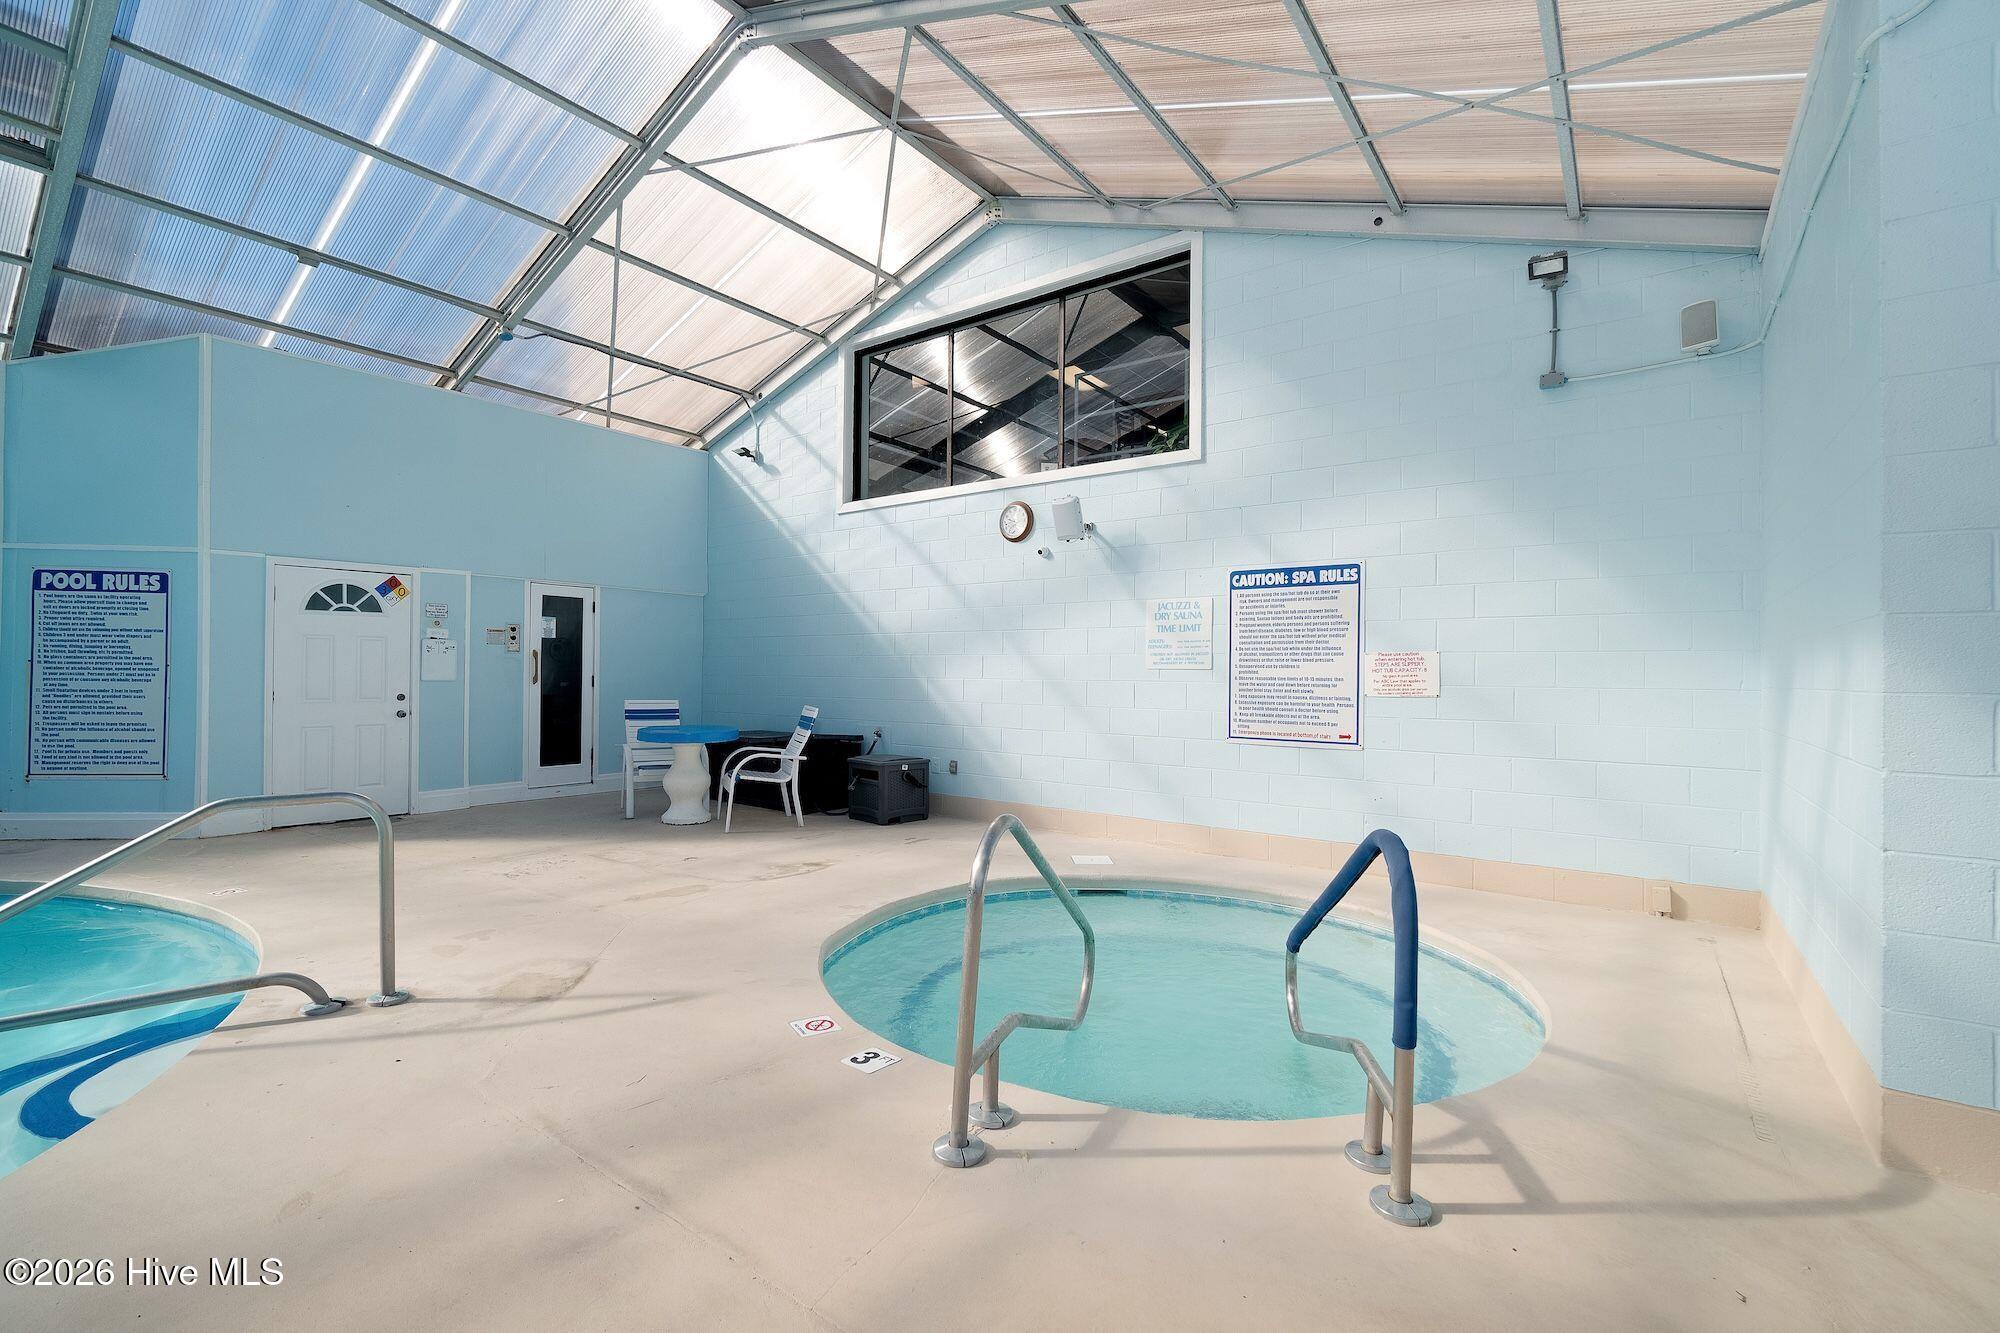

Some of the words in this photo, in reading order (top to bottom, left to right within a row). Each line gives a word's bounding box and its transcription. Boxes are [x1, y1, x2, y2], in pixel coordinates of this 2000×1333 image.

[40, 572, 97, 590] POOL
[102, 574, 160, 591] RULES
[1232, 571, 1288, 587] CAUTION:
[1292, 570, 1316, 584] SPA
[1320, 568, 1358, 582] RULES
[382, 586, 387, 594] 3
[1154, 612, 1170, 620] DRY
[1174, 611, 1202, 620] SAUNA
[1156, 624, 1176, 632] TIME
[1180, 624, 1202, 632] LIMIT
[850, 1052, 880, 1064] 3
